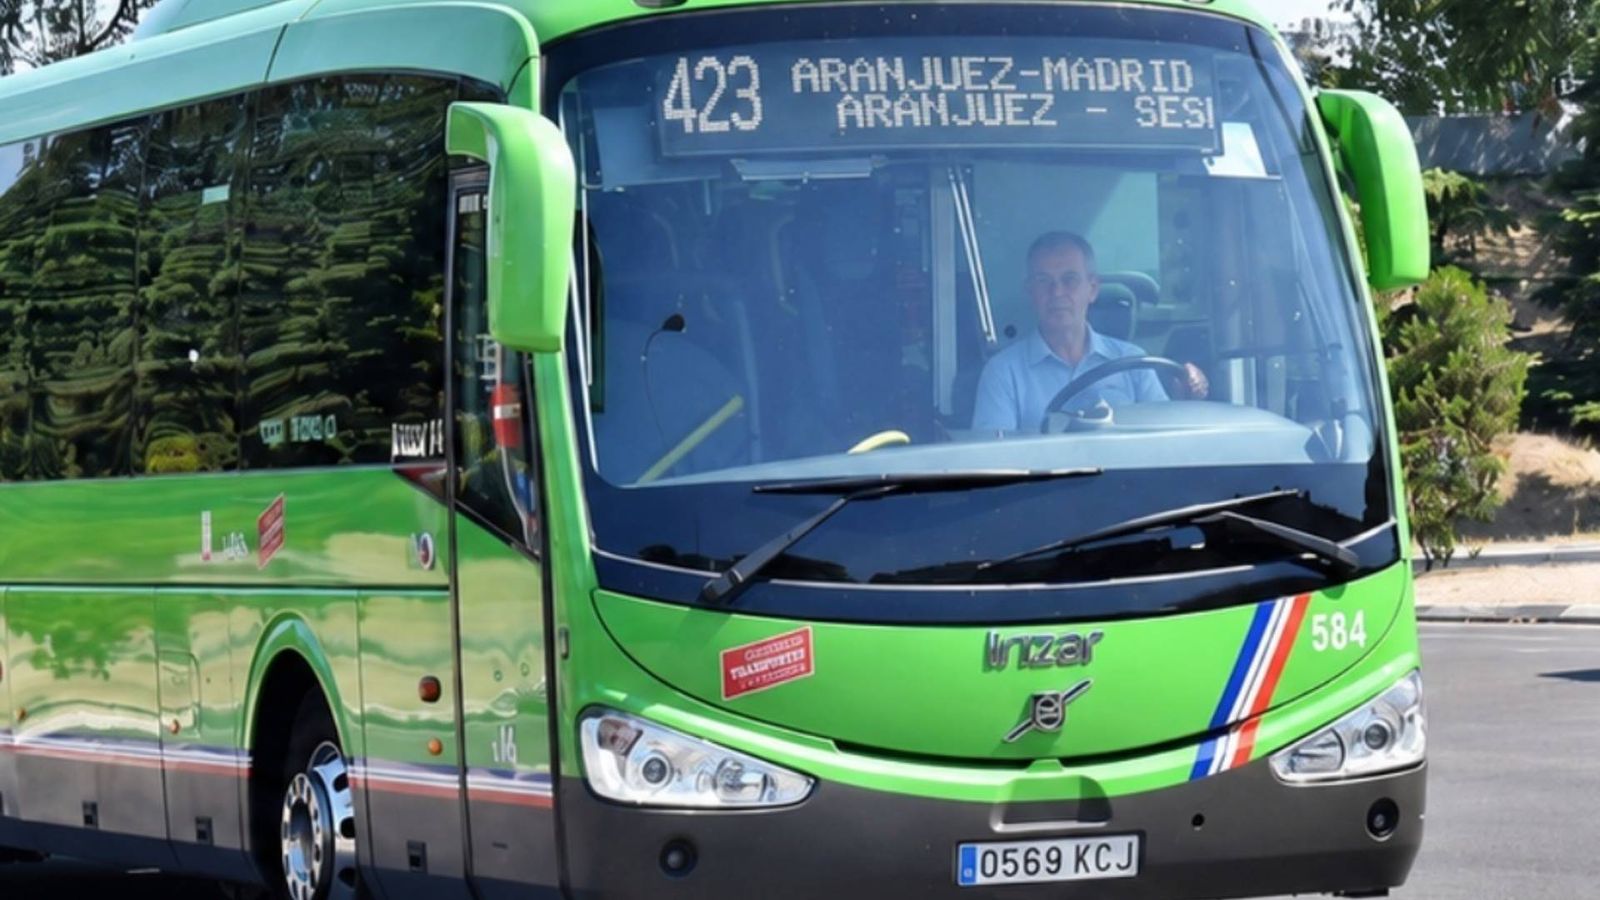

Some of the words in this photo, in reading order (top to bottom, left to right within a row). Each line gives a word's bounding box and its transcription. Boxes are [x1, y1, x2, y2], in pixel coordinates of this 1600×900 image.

[792, 56, 1194, 94] ARANJUEZ-MADRID
[663, 56, 762, 133] 423
[836, 92, 1057, 128] ARANJUEZ
[1311, 610, 1367, 652] 584
[980, 846, 1062, 878] 0569
[1074, 841, 1134, 874] KCJ
